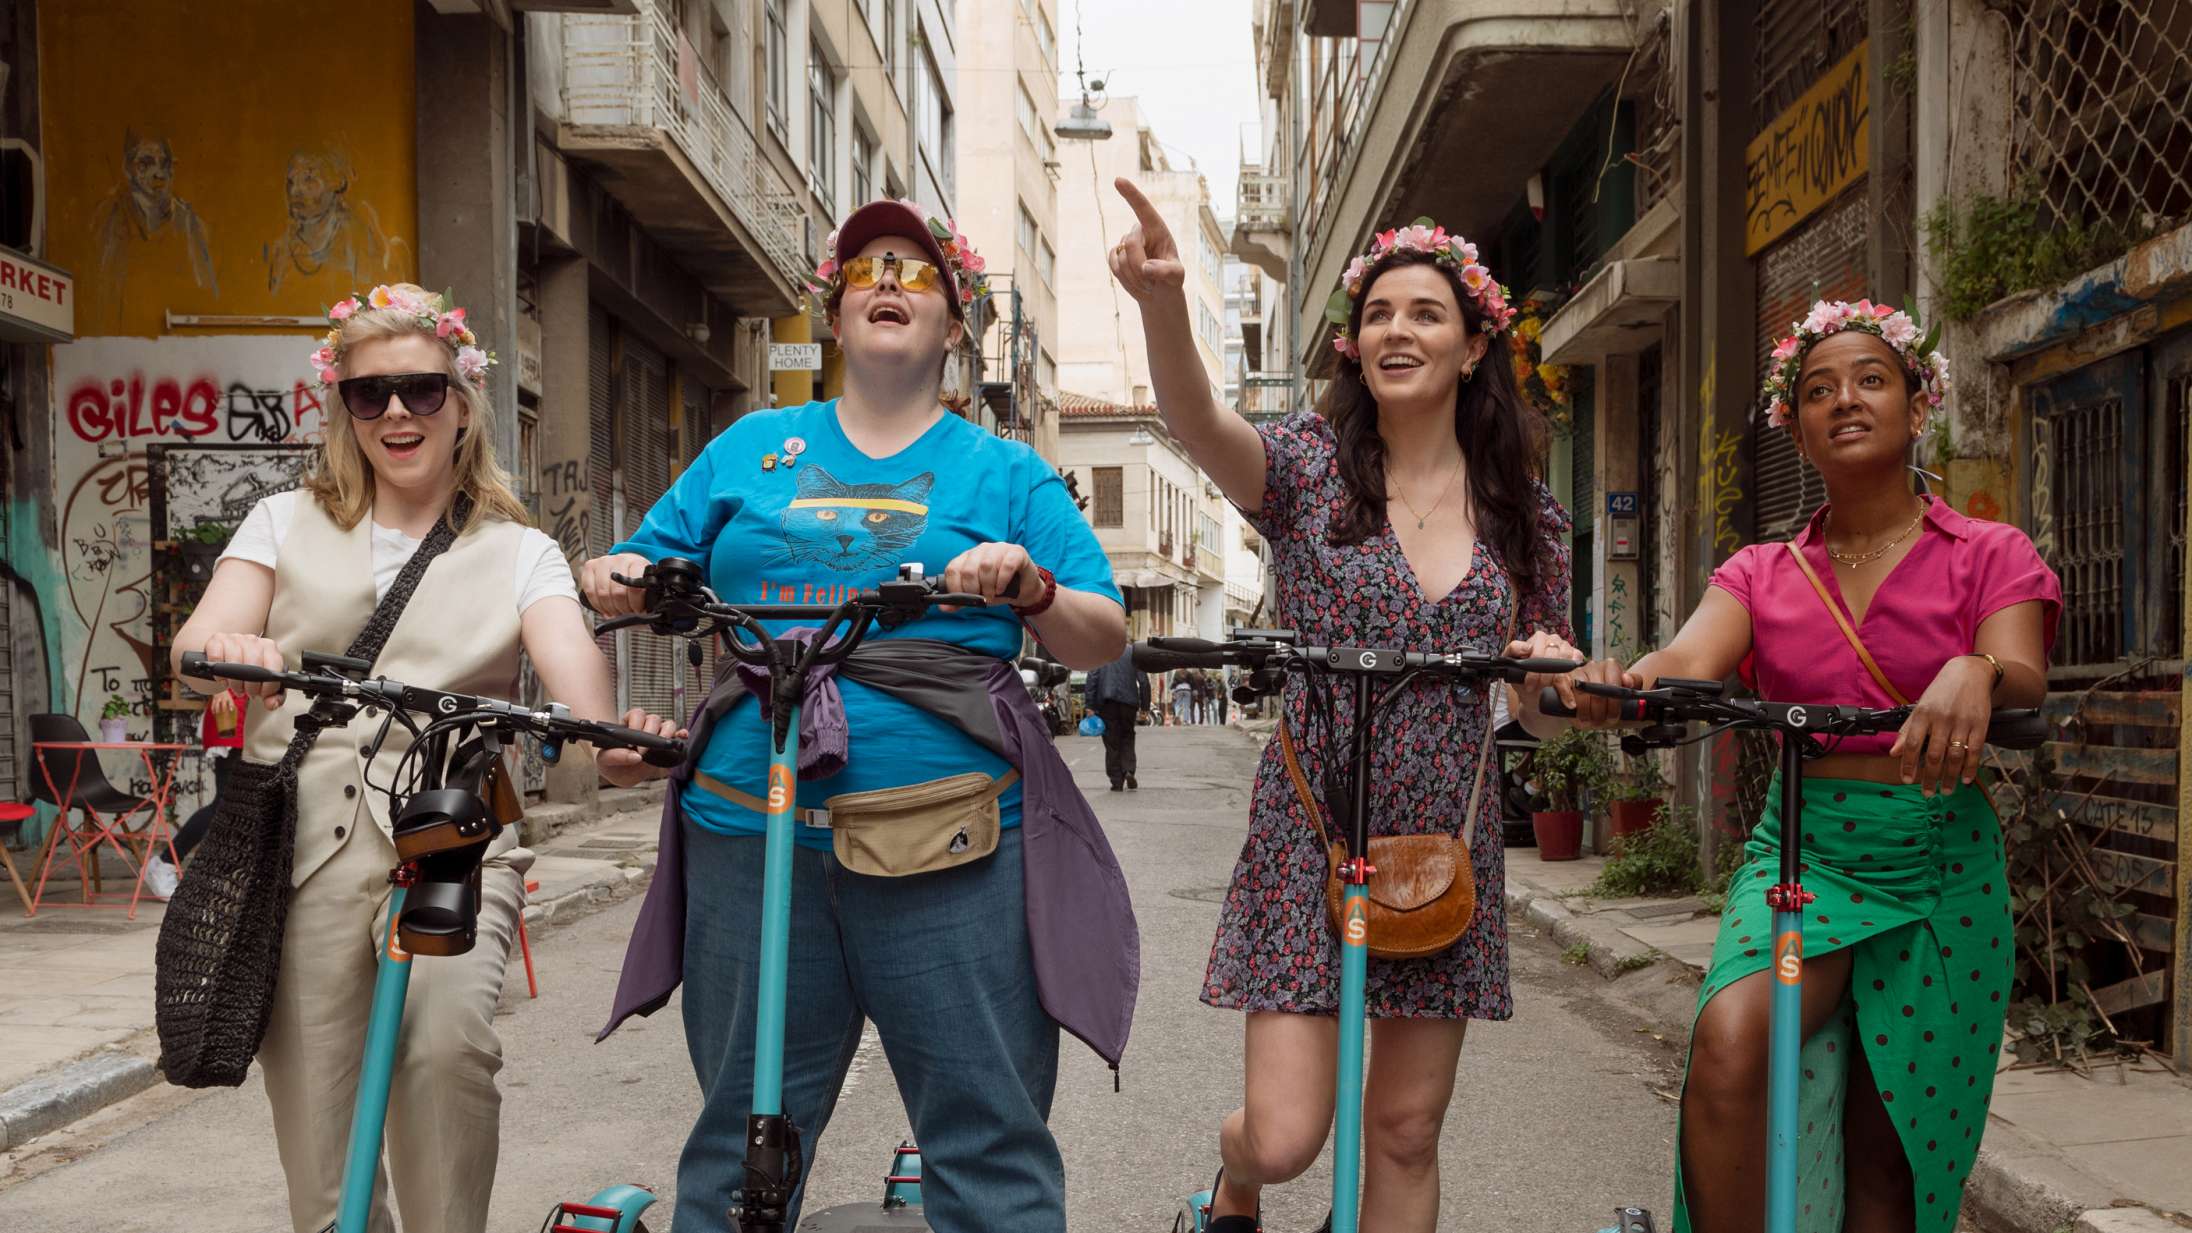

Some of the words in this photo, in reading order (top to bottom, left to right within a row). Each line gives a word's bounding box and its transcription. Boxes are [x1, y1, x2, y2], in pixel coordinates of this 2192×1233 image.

[768, 345, 818, 357] PLENTY
[774, 357, 813, 369] HOME
[1610, 496, 1634, 512] 42
[761, 580, 795, 602] I'm
